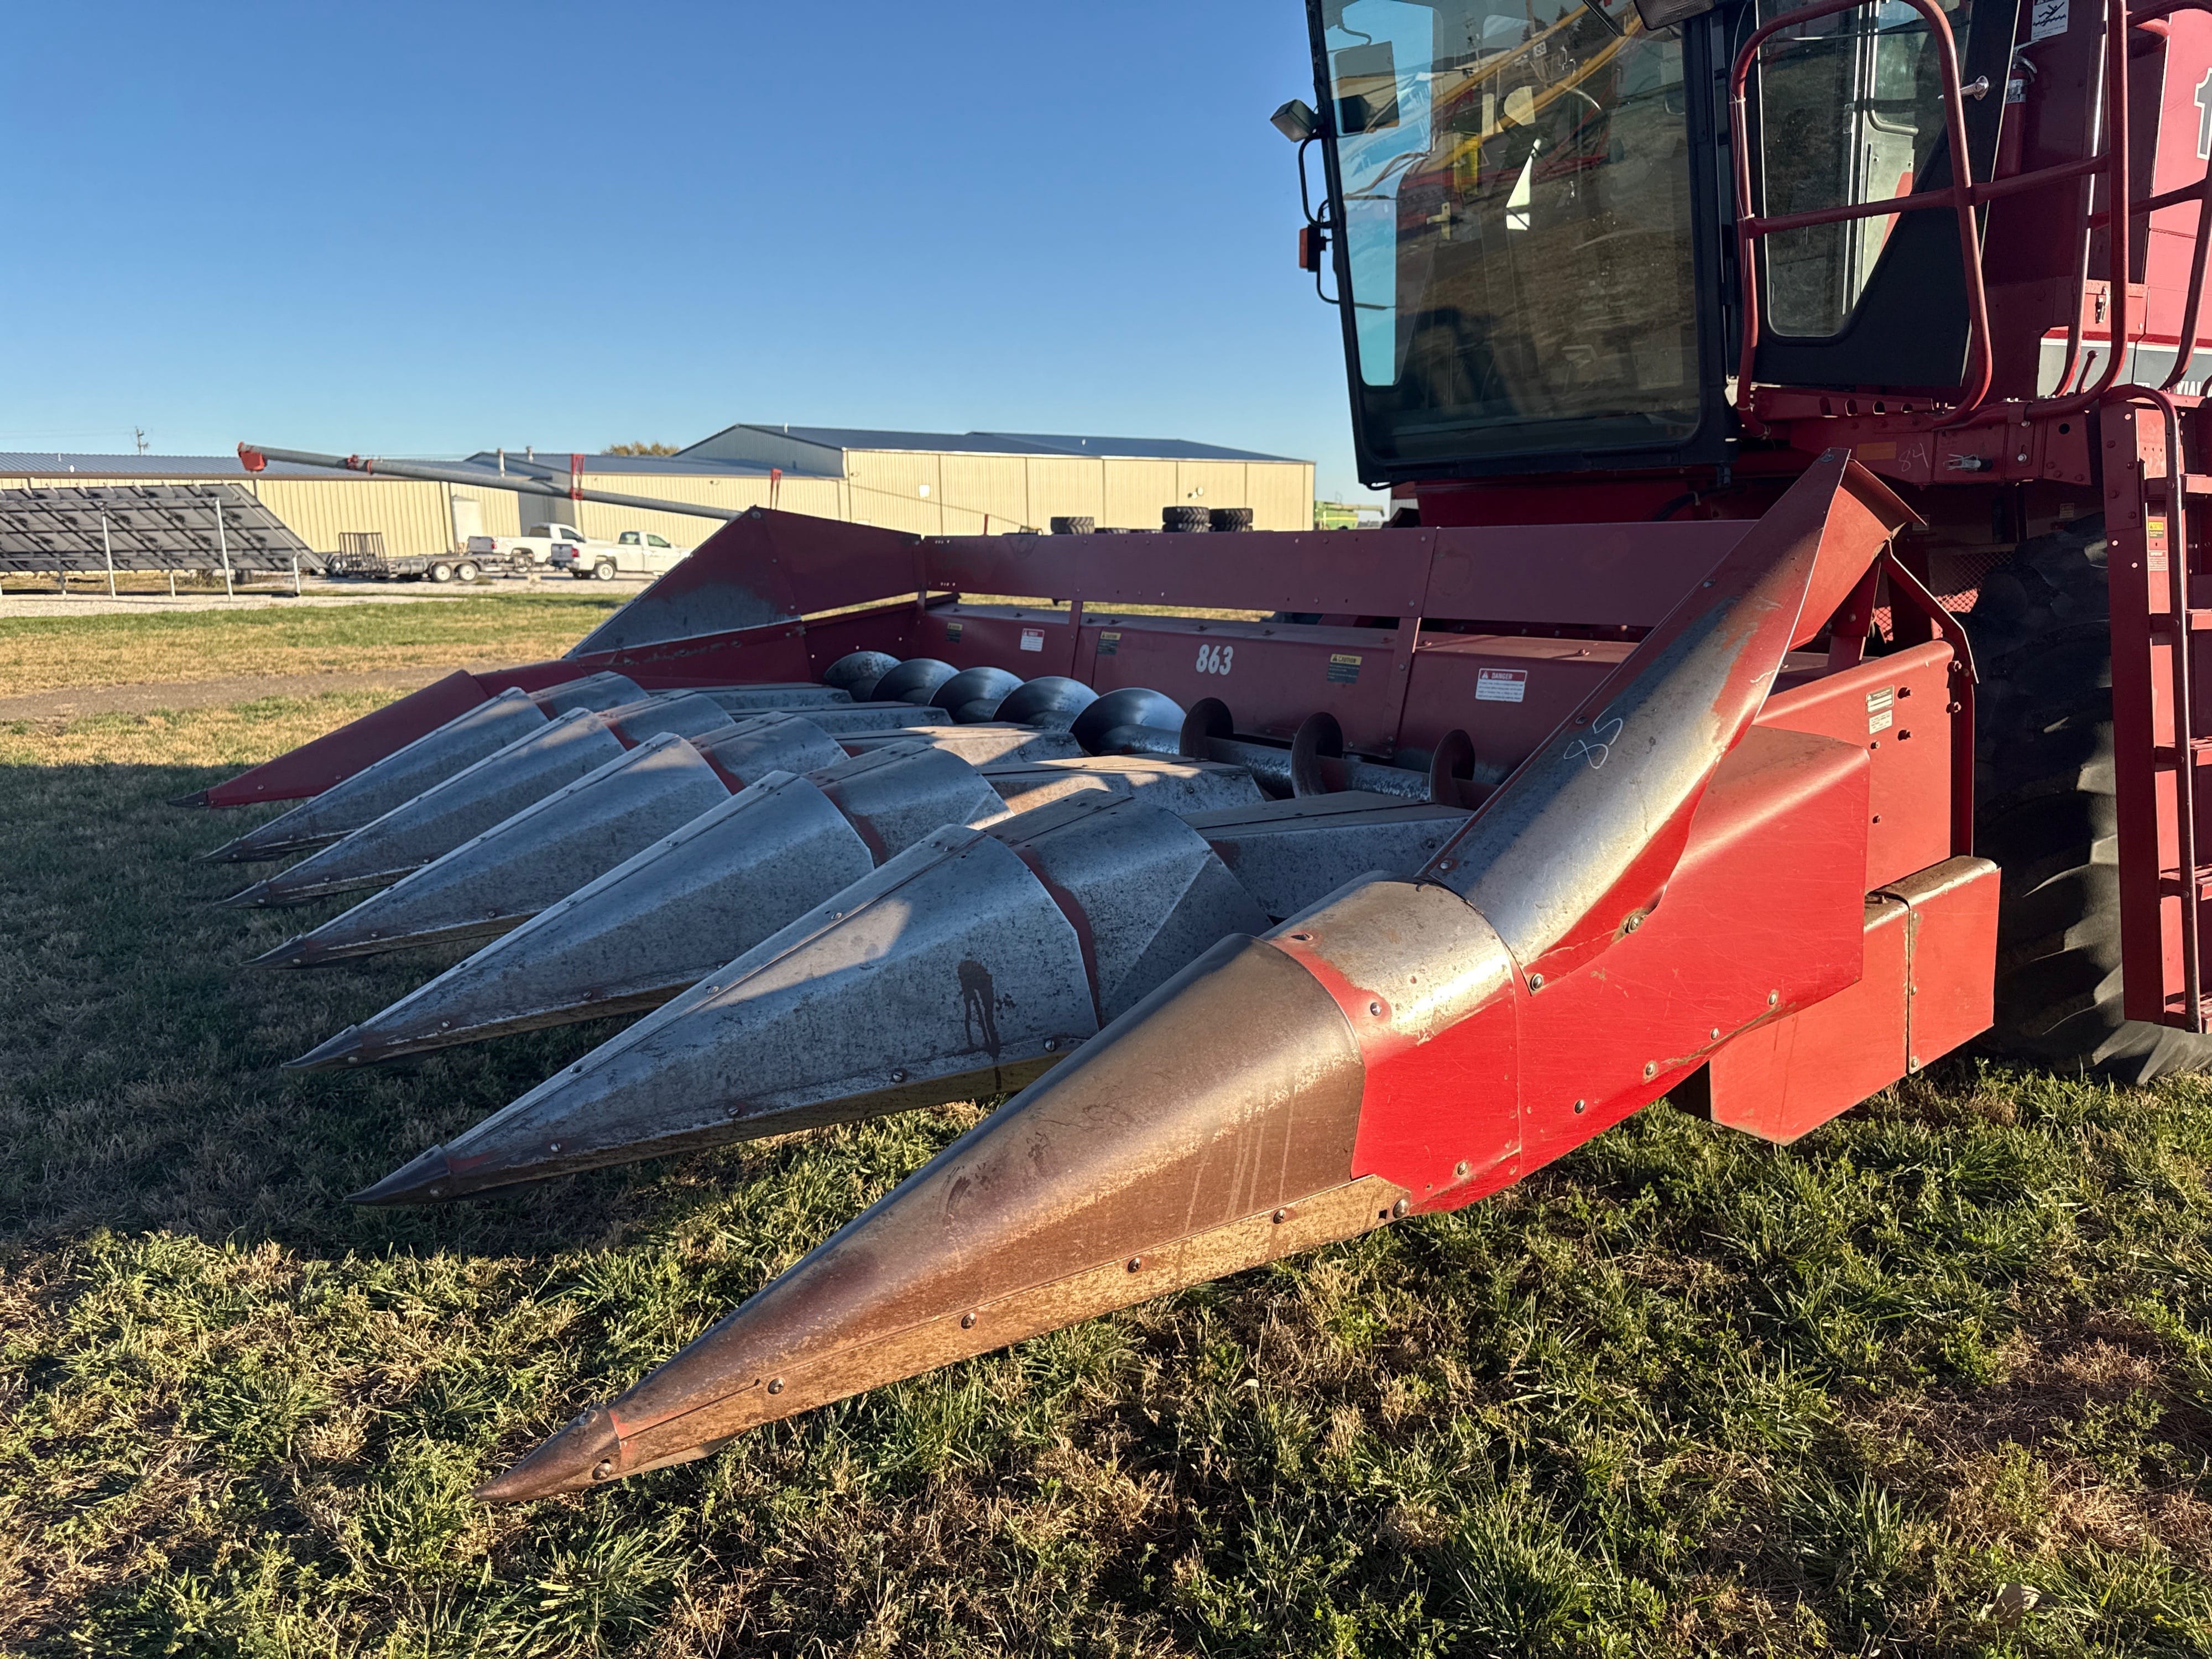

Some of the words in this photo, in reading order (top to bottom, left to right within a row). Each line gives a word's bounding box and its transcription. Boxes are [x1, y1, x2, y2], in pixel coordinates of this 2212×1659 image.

[1898, 442, 1929, 472] 84
[1196, 644, 1234, 675] 863
[1563, 703, 1623, 769] 85
